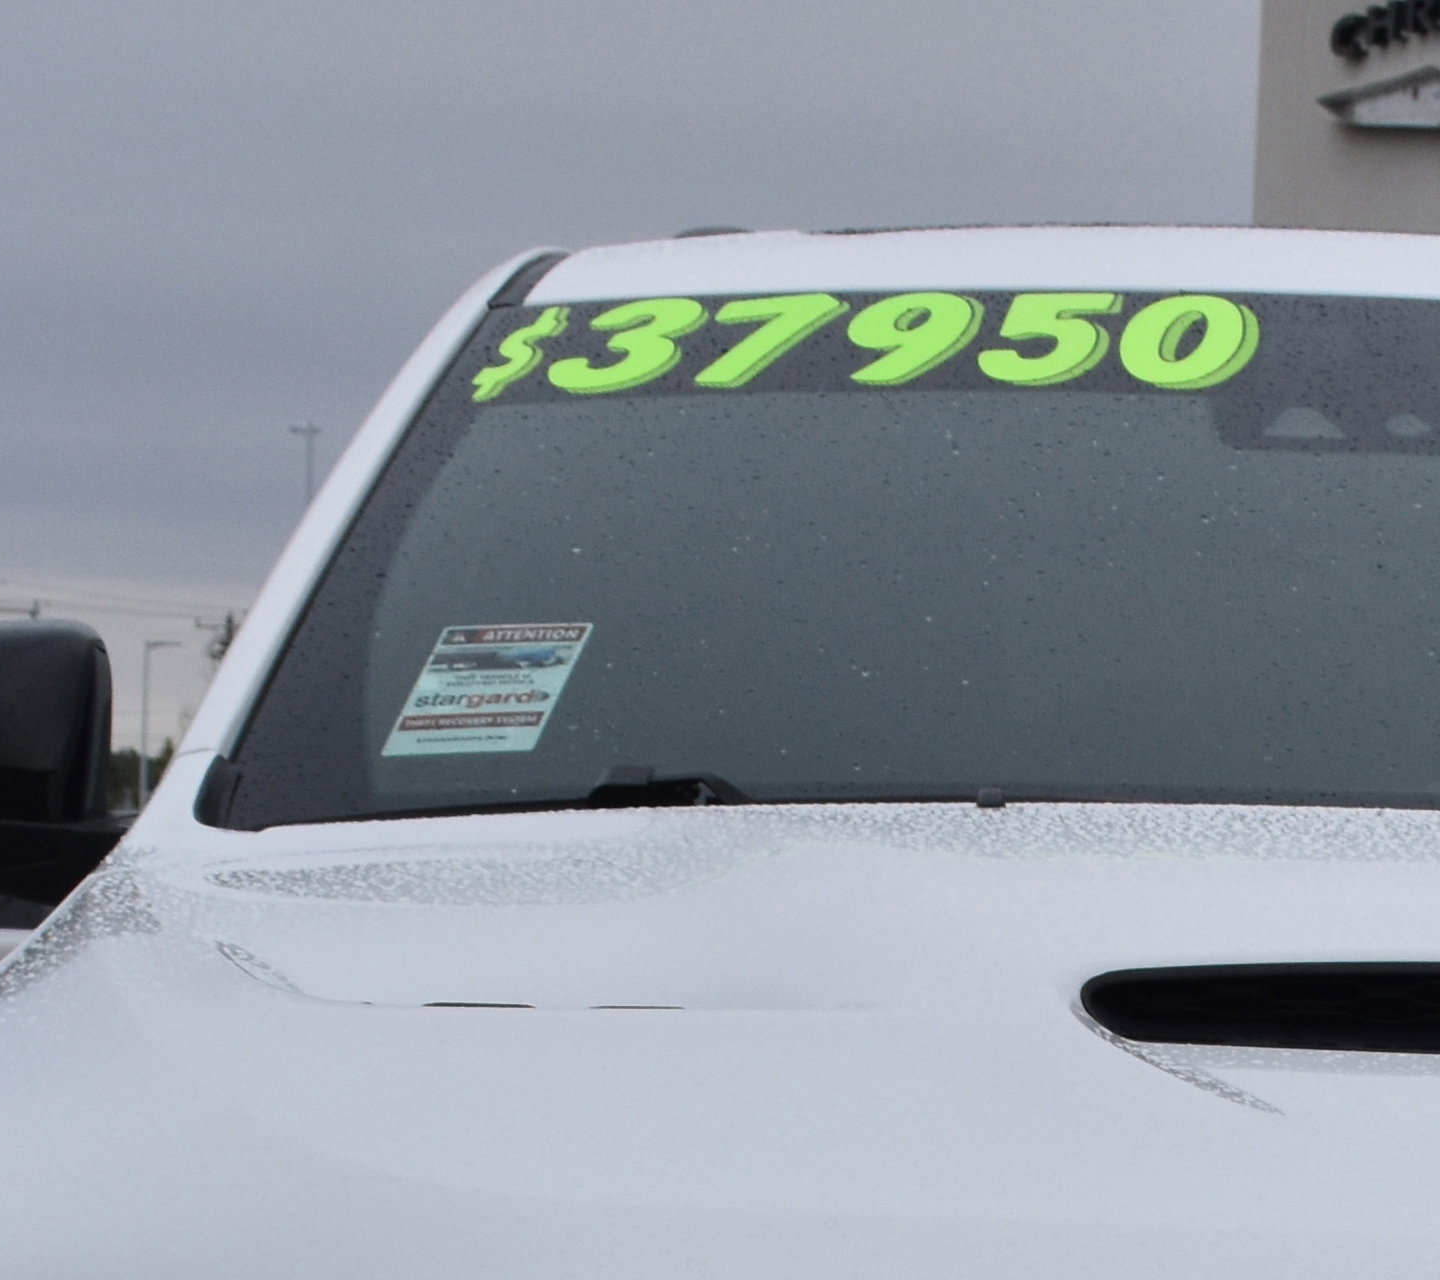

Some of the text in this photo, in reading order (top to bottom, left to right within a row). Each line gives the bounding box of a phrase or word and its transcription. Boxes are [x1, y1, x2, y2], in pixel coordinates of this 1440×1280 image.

[474, 293, 1259, 400] $37950
[482, 629, 581, 642] ATTENTION
[414, 689, 540, 709] stargard
